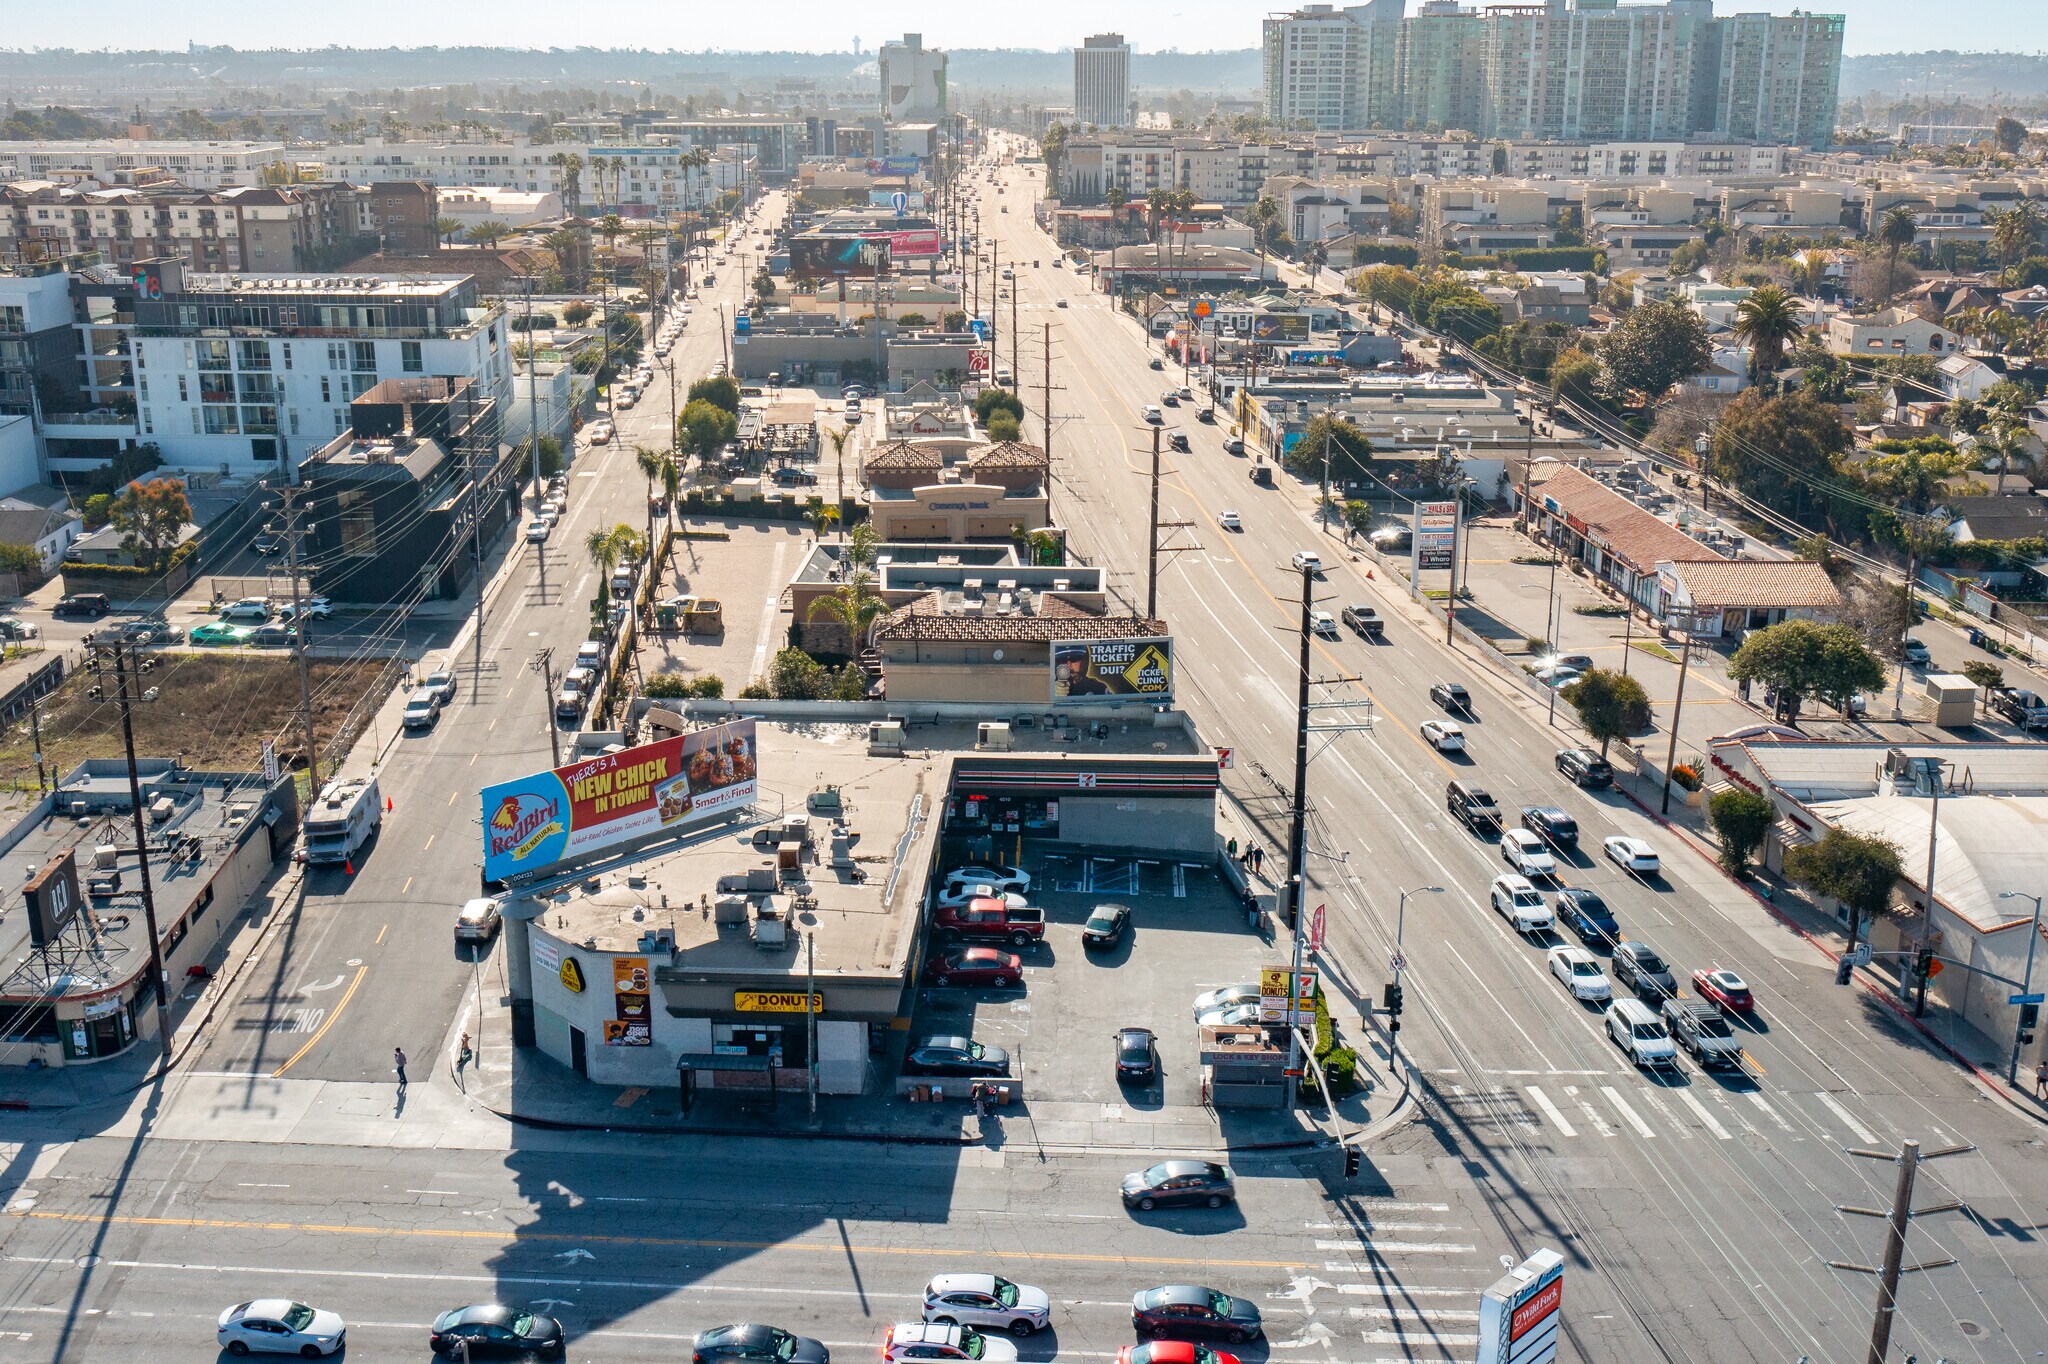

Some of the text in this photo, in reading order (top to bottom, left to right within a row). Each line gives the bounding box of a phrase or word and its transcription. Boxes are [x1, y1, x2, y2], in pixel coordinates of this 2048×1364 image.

[1428, 505, 1443, 513] NAILS
[1091, 644, 1135, 654] TRAFFIC
[1091, 653, 1135, 663] TICKET?
[1100, 665, 1125, 675] DUI?
[1137, 668, 1165, 676] TICKET
[1137, 676, 1165, 684] CLINIC
[1140, 684, 1162, 692] .COM
[1217, 750, 1230, 767] 7
[566, 756, 617, 787] THERE'S A
[573, 757, 668, 802] NEW CHICK
[1082, 774, 1093, 787] 7
[595, 785, 650, 813] IN TOWN!
[491, 797, 559, 857] RedBird
[571, 814, 657, 846] What Real Chicken Tastes Like!
[520, 825, 554, 854] ALL NATURAL
[1262, 987, 1288, 996] DONUTS
[1300, 977, 1311, 996] 7
[758, 995, 821, 1006] DONUTS
[1522, 1288, 1558, 1320] Wild Fork
